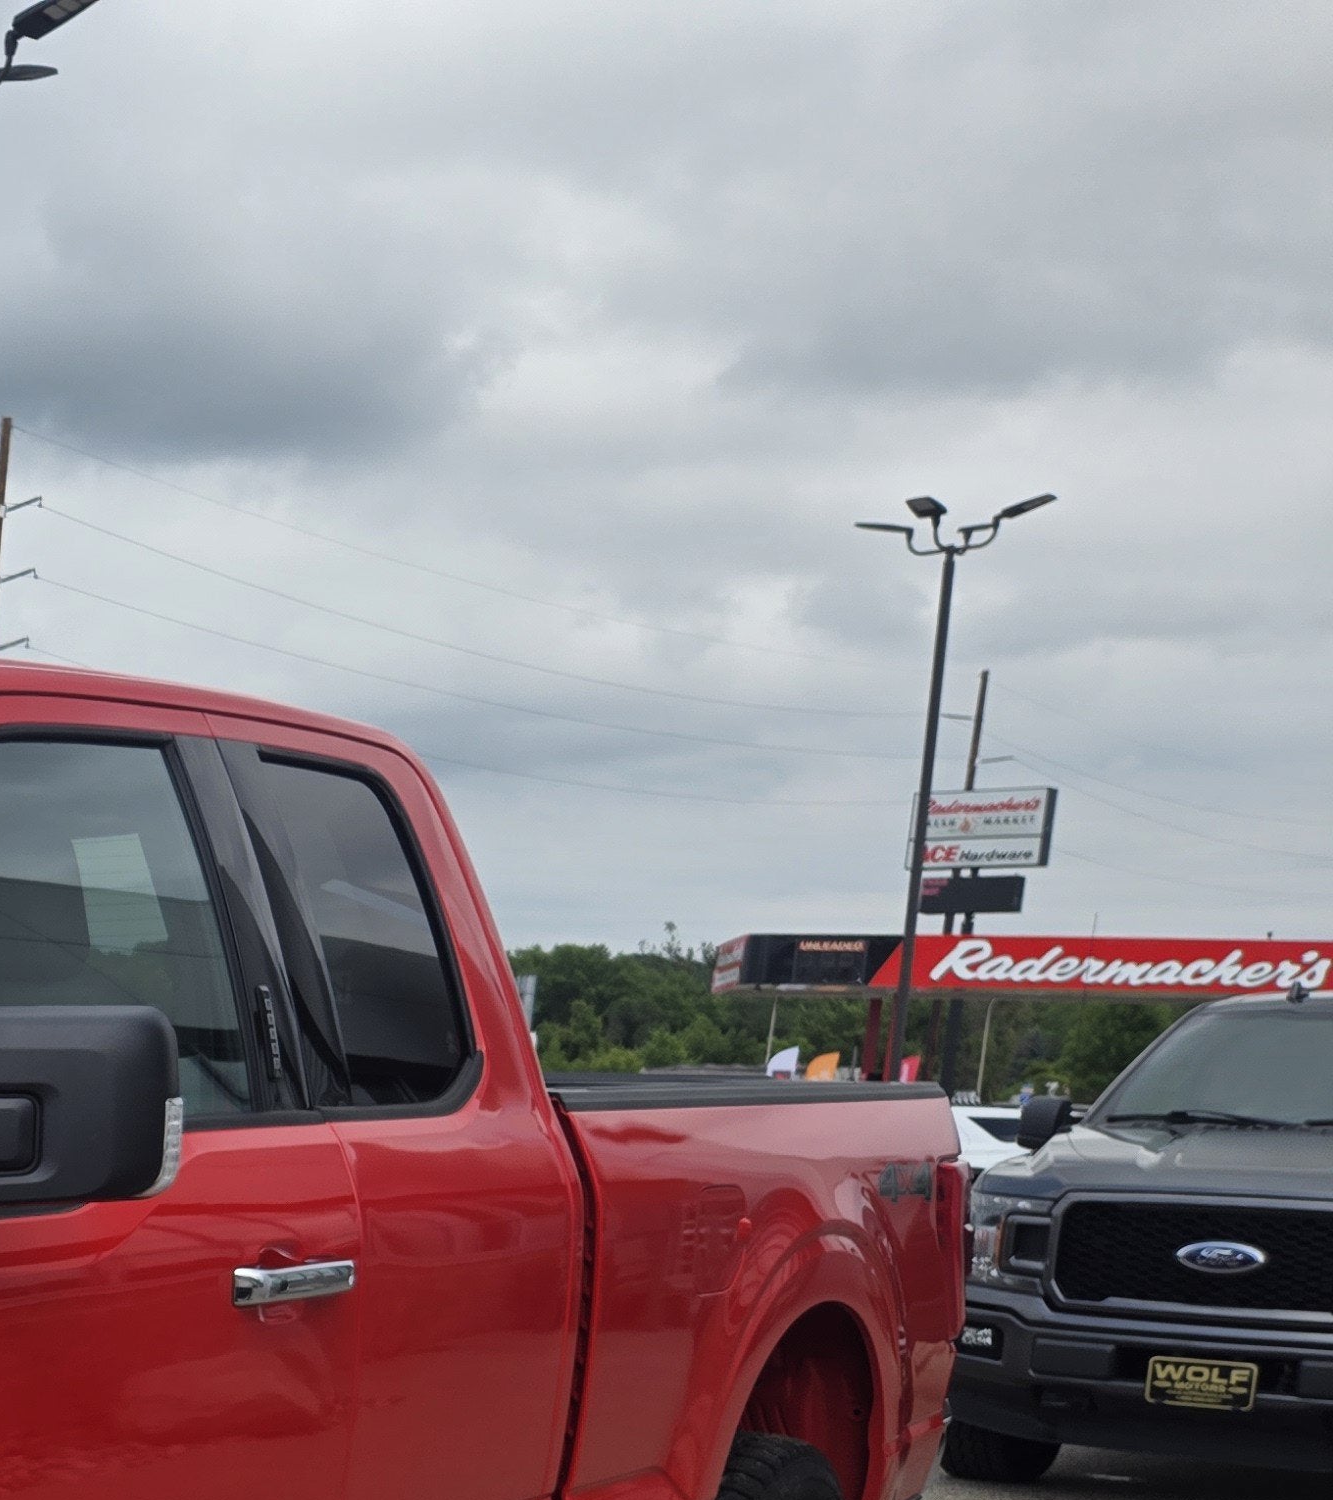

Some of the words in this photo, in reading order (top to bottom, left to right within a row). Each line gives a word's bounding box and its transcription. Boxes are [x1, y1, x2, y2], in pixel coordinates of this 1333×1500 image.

[959, 849, 1033, 862] Hardware
[929, 938, 1332, 989] Radermacher's
[1155, 1362, 1251, 1385] WOLF
[1174, 1381, 1226, 1393] MOTORS
